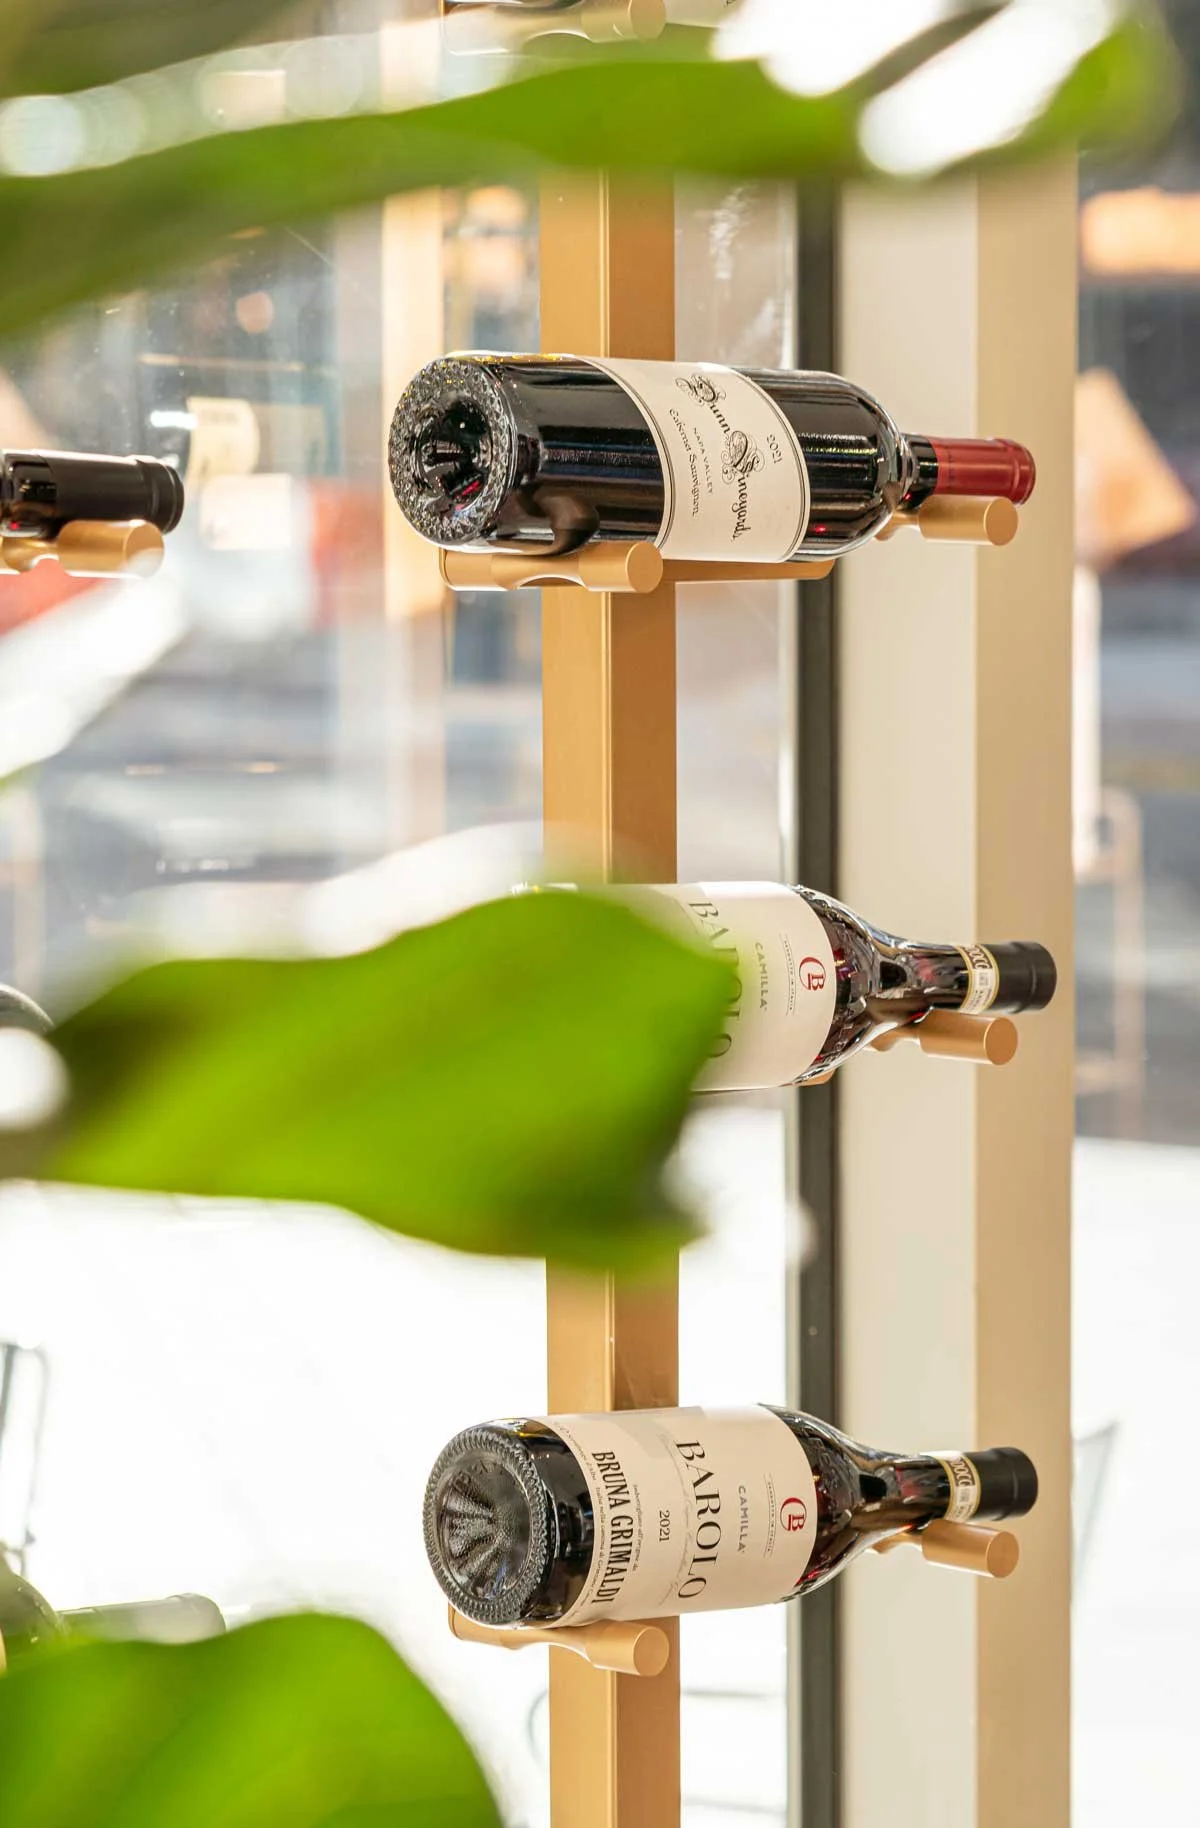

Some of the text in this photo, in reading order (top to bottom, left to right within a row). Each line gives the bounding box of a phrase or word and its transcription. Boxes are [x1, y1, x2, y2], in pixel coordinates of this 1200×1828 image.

[669, 408, 702, 517] Cabernet Sauvignon
[675, 372, 766, 542] Dunn Vineyards
[703, 456, 714, 495] VALLEY
[766, 433, 783, 464] 2021
[591, 1451, 634, 1604] BRUNA GRIMALDI
[659, 1510, 670, 1542] 2021
[674, 1440, 722, 1598] BAROLO
